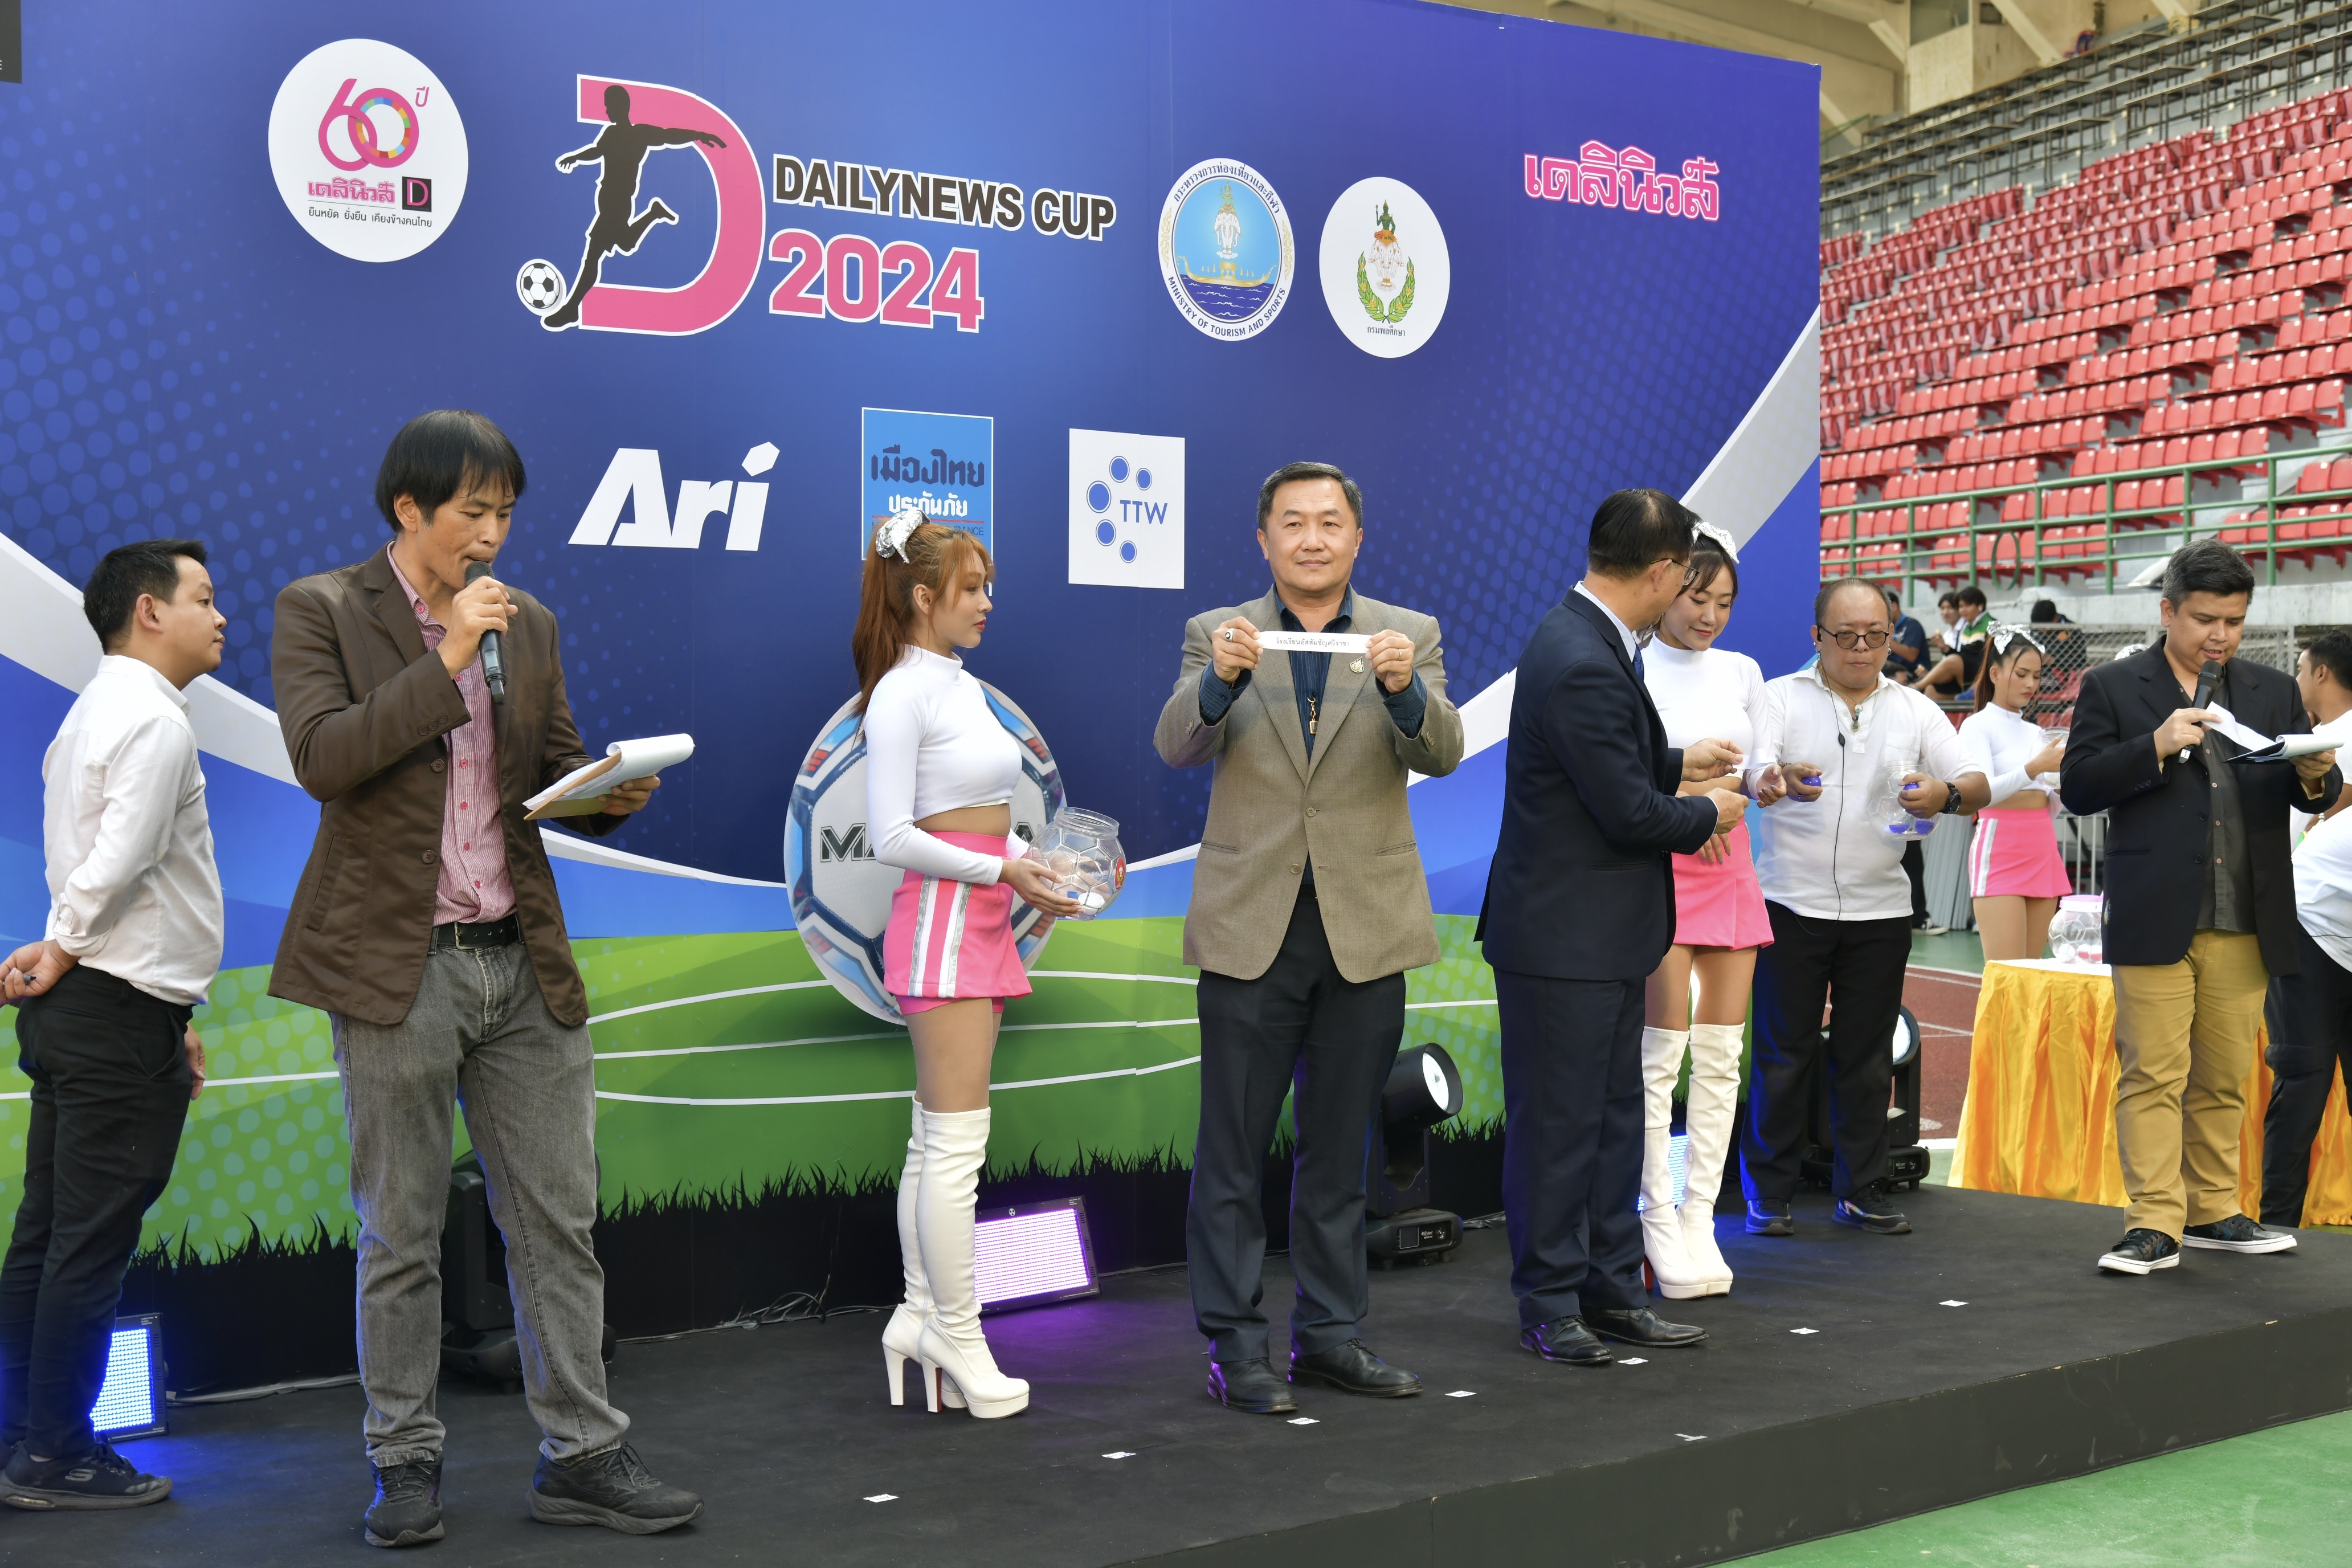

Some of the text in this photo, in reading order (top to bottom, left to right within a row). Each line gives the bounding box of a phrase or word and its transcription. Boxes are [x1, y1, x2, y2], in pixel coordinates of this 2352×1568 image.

[415, 86, 430, 107] ปี
[318, 78, 419, 172] 60
[308, 176, 395, 204] เดลินิวส์
[773, 154, 1116, 241] DAILYNEWS CUP
[1174, 162, 1280, 214] กระทรวงการท่องเที่ยวและกีฬา
[1524, 139, 1719, 222] เดลินิวส์
[309, 207, 432, 227] ยืนหยัด ยั่งยืน เคียงข้างคนไทย
[769, 228, 984, 333] 2024
[1169, 276, 1285, 337] MINISTRY OF TOURISM AND SPORTS
[1367, 325, 1405, 336] กรมพลศึกษา
[871, 444, 985, 488] เมืองไทย
[567, 442, 780, 551] Ari
[1120, 499, 1168, 525] TTW
